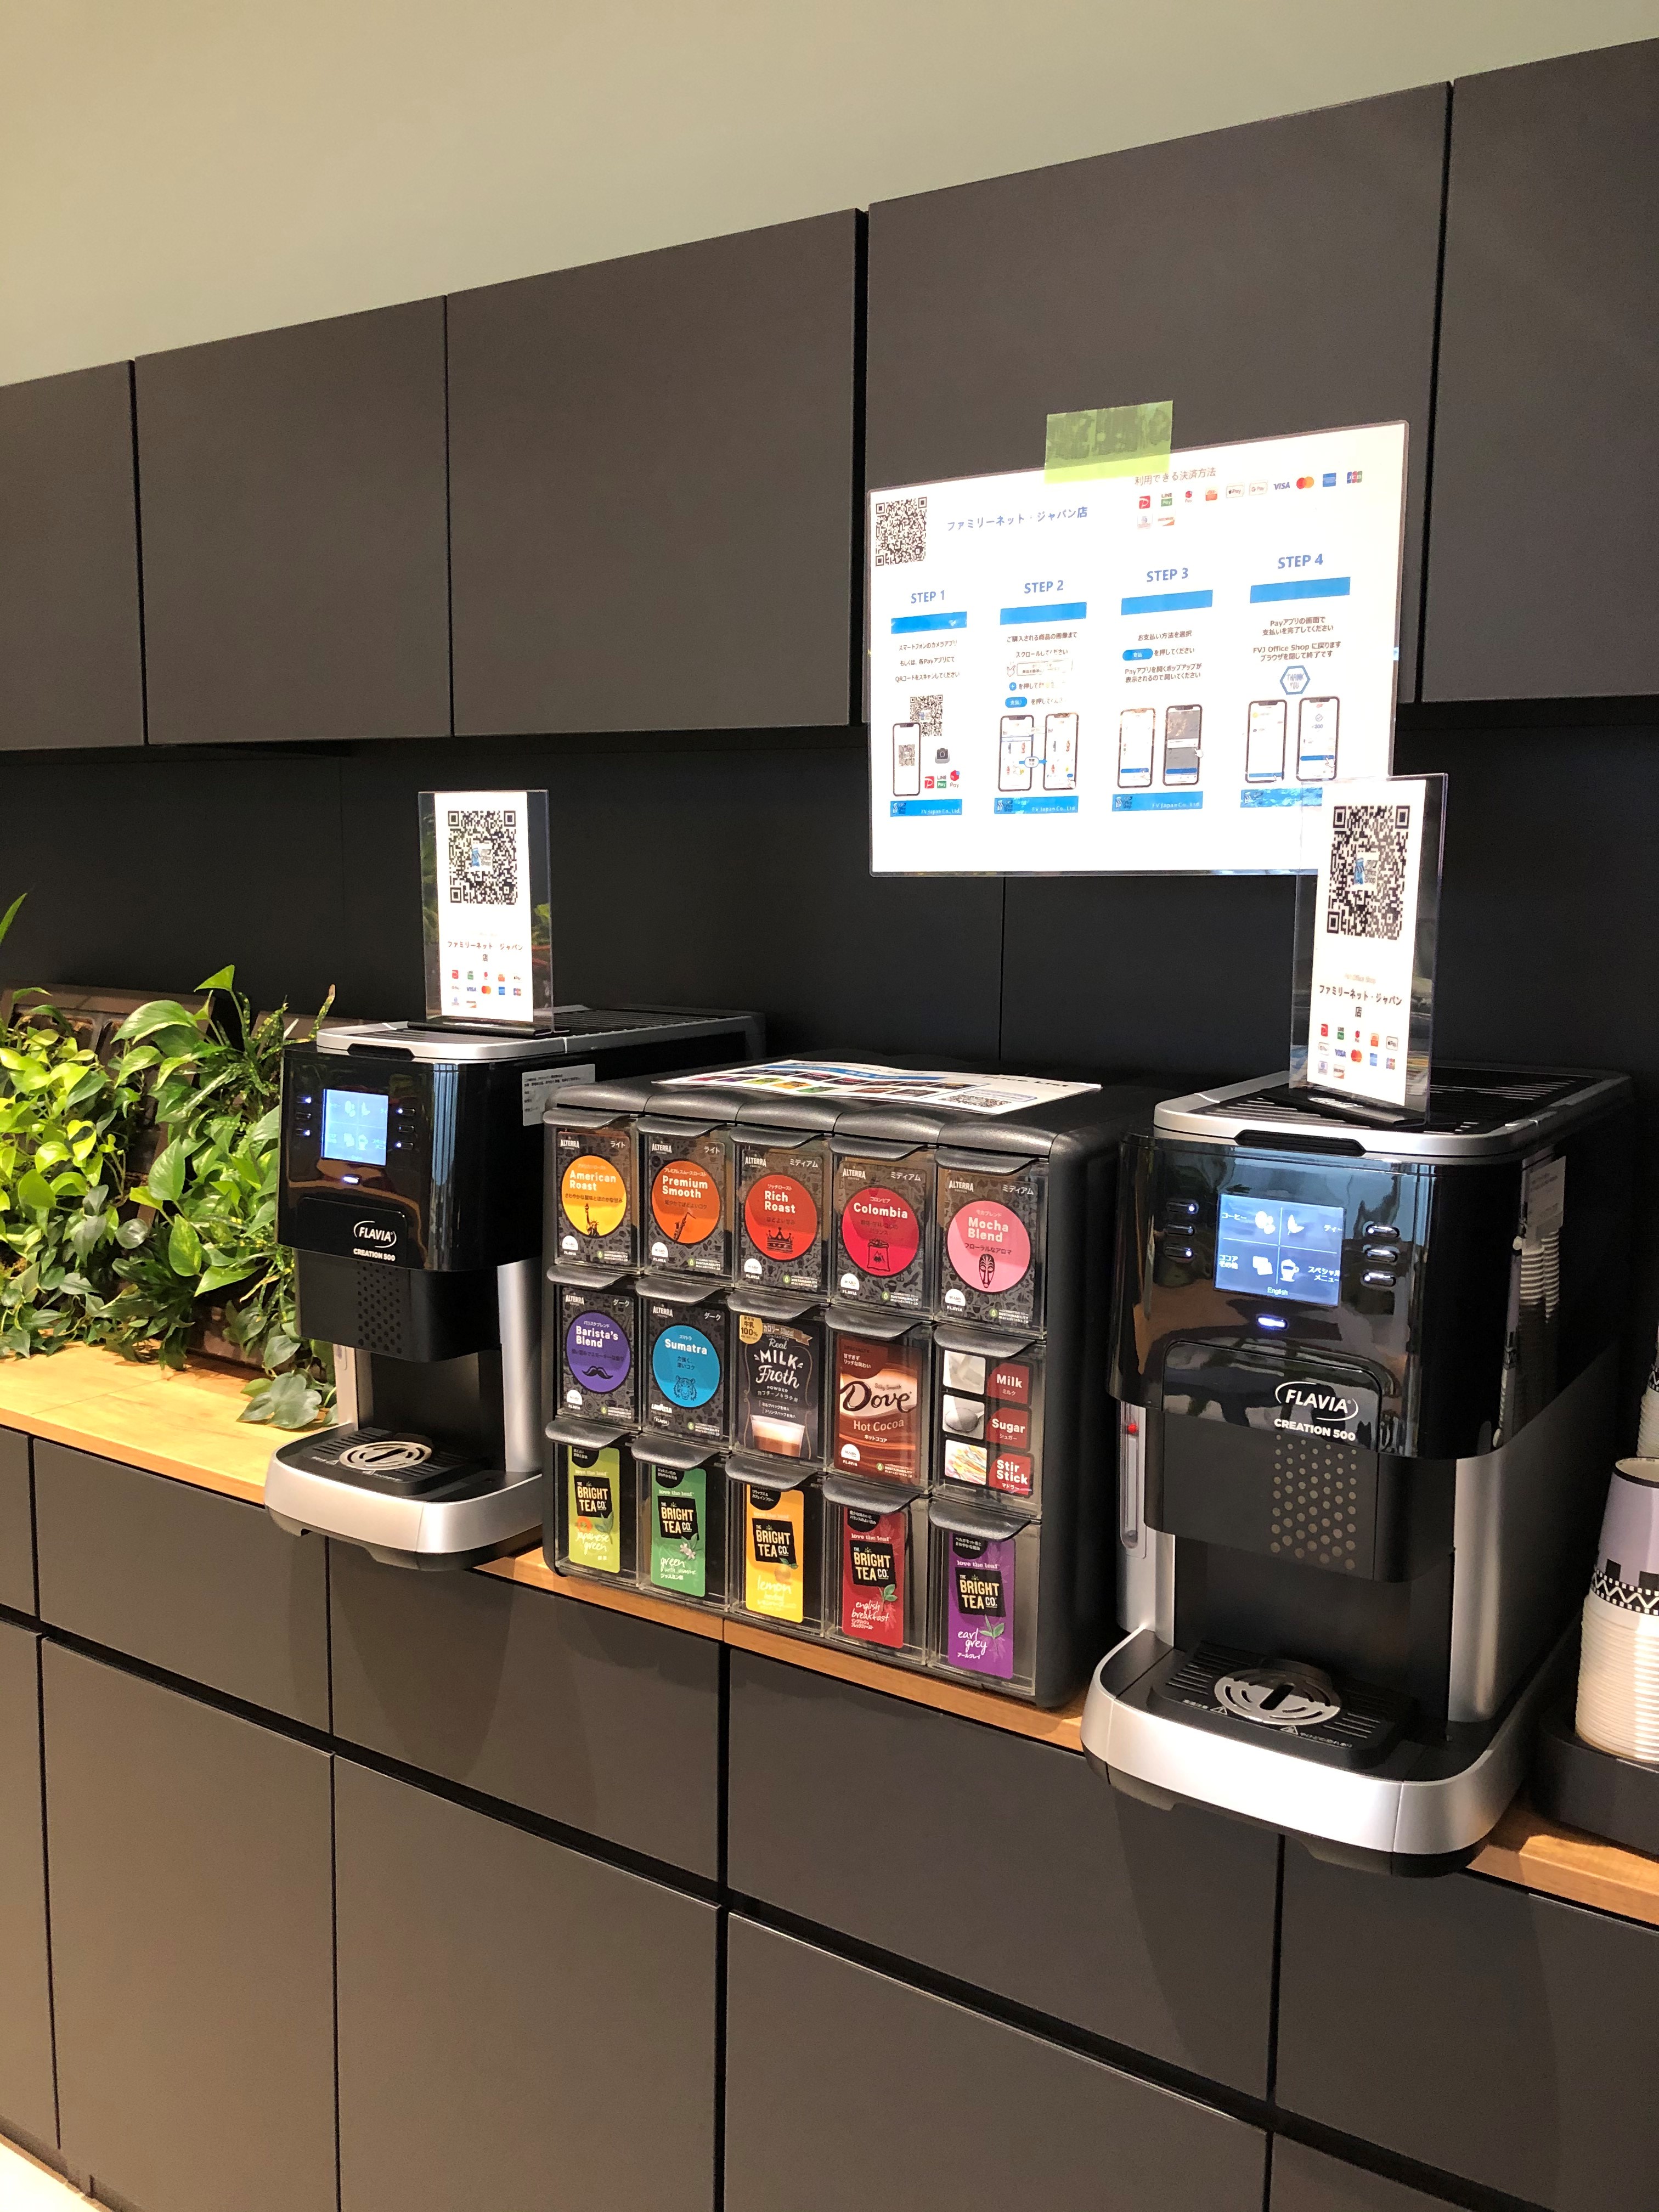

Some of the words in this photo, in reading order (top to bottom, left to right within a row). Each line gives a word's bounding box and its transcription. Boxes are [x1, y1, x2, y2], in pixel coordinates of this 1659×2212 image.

[1135, 467, 1216, 486] 利用できる決済方法
[1273, 482, 1290, 490] VISA
[947, 506, 1088, 531] ファミリーネット・ジャパン店
[1278, 555, 1311, 569] STEP
[1315, 554, 1323, 565] 4
[1147, 569, 1177, 583] STEP
[1182, 568, 1189, 579] 3
[1024, 582, 1053, 594] STEP
[1057, 580, 1064, 591] 2
[911, 591, 936, 603] STEP
[940, 590, 945, 601] 1
[1270, 616, 1325, 627] Payアプリの画面で
[1138, 630, 1192, 641] お支払い方法を選択
[1262, 625, 1334, 636] 支払いを完了してください
[1154, 647, 1194, 656] を押してください
[1260, 650, 1333, 662] ブラウザを閉じて終了です
[482, 953, 488, 962] 店
[1319, 984, 1402, 1006] ファミリーネット・ジャパン
[1355, 1006, 1362, 1018] 店
[1334, 1048, 1346, 1058] VISA
[560, 1139, 580, 1149] ALTERRA
[652, 1143, 672, 1154] ALTERRA
[704, 1146, 720, 1154] ライト
[745, 1156, 766, 1167] ALTERRA
[790, 1158, 819, 1167] ミディアム
[569, 1170, 616, 1183] American
[843, 1168, 866, 1180] ALTERRA
[890, 1171, 921, 1181] ミディアム
[569, 1180, 597, 1191] Roast
[662, 1175, 708, 1189] Premium
[949, 1180, 974, 1192] ALTERRA
[662, 1186, 701, 1199] Smooth
[1002, 1184, 1034, 1195] ミディアム
[765, 1190, 788, 1203] Rich
[765, 1200, 795, 1214] Roast
[854, 1202, 908, 1219] Colombia
[1222, 1212, 1246, 1221] コーヒー
[968, 1216, 1009, 1233] Mocha
[1324, 1224, 1343, 1233] ティー
[359, 1226, 391, 1242] FLAVIA
[968, 1228, 1003, 1243] Blend
[353, 1248, 383, 1260] CREATION
[383, 1253, 396, 1261] 500
[964, 1243, 1012, 1255] フローラルなアロマ
[1308, 1266, 1340, 1277] スペシャル
[1314, 1274, 1339, 1283] メニュー
[1267, 1286, 1288, 1296] English
[565, 1294, 584, 1305] ALTERRA
[613, 1299, 630, 1307] ダーク
[653, 1305, 673, 1317] ALTERRA
[704, 1312, 721, 1321] ダーク
[744, 1320, 755, 1329] 牛乳
[763, 1325, 779, 1335] カロリー
[576, 1325, 618, 1341] Barista's
[741, 1327, 758, 1337] 100%
[576, 1336, 602, 1348] Blend
[664, 1338, 708, 1355] Sumatra
[769, 1338, 787, 1350] Real
[760, 1350, 800, 1370] MILK
[843, 1353, 860, 1361] 甘すぎず
[844, 1358, 872, 1369] リッチな味わい
[755, 1364, 800, 1389] Froth
[996, 1374, 1023, 1389] Milk
[840, 1380, 917, 1413] Dove
[1285, 1389, 1348, 1414] FLAVIA
[854, 1420, 871, 1432] Hot
[873, 1419, 904, 1432] Cocoa
[992, 1418, 1025, 1434] Sugar
[1274, 1418, 1331, 1437] CREATION
[1333, 1429, 1356, 1441] 500
[864, 1434, 888, 1443] ホットココア
[997, 1459, 1020, 1472] Stir
[996, 1469, 1028, 1485] Stick
[577, 1486, 608, 1500] BRIGHT
[1002, 1482, 1020, 1491] マドラー
[752, 1494, 774, 1503] カフェインフリー
[579, 1499, 596, 1512] TEA
[661, 1506, 693, 1521] BRIGHT
[663, 1520, 681, 1534] TEA
[682, 1522, 692, 1531] CO.
[576, 1529, 610, 1544] japanese
[756, 1530, 791, 1545] BRIGHT
[584, 1540, 607, 1555] green
[758, 1544, 777, 1558] TEA
[778, 1545, 789, 1555] CO.
[661, 1556, 685, 1572] green
[854, 1551, 891, 1568] BRIGHT
[855, 1566, 877, 1581] TEA
[878, 1568, 889, 1578] CO.
[757, 1575, 792, 1595] lemon
[960, 1579, 1000, 1596] BRIGHT
[855, 1600, 881, 1614] english
[961, 1594, 984, 1610] TEA
[985, 1596, 997, 1607] CO.
[851, 1608, 889, 1622] breakfast
[957, 1628, 979, 1640] earl
[965, 1639, 988, 1656] grey
